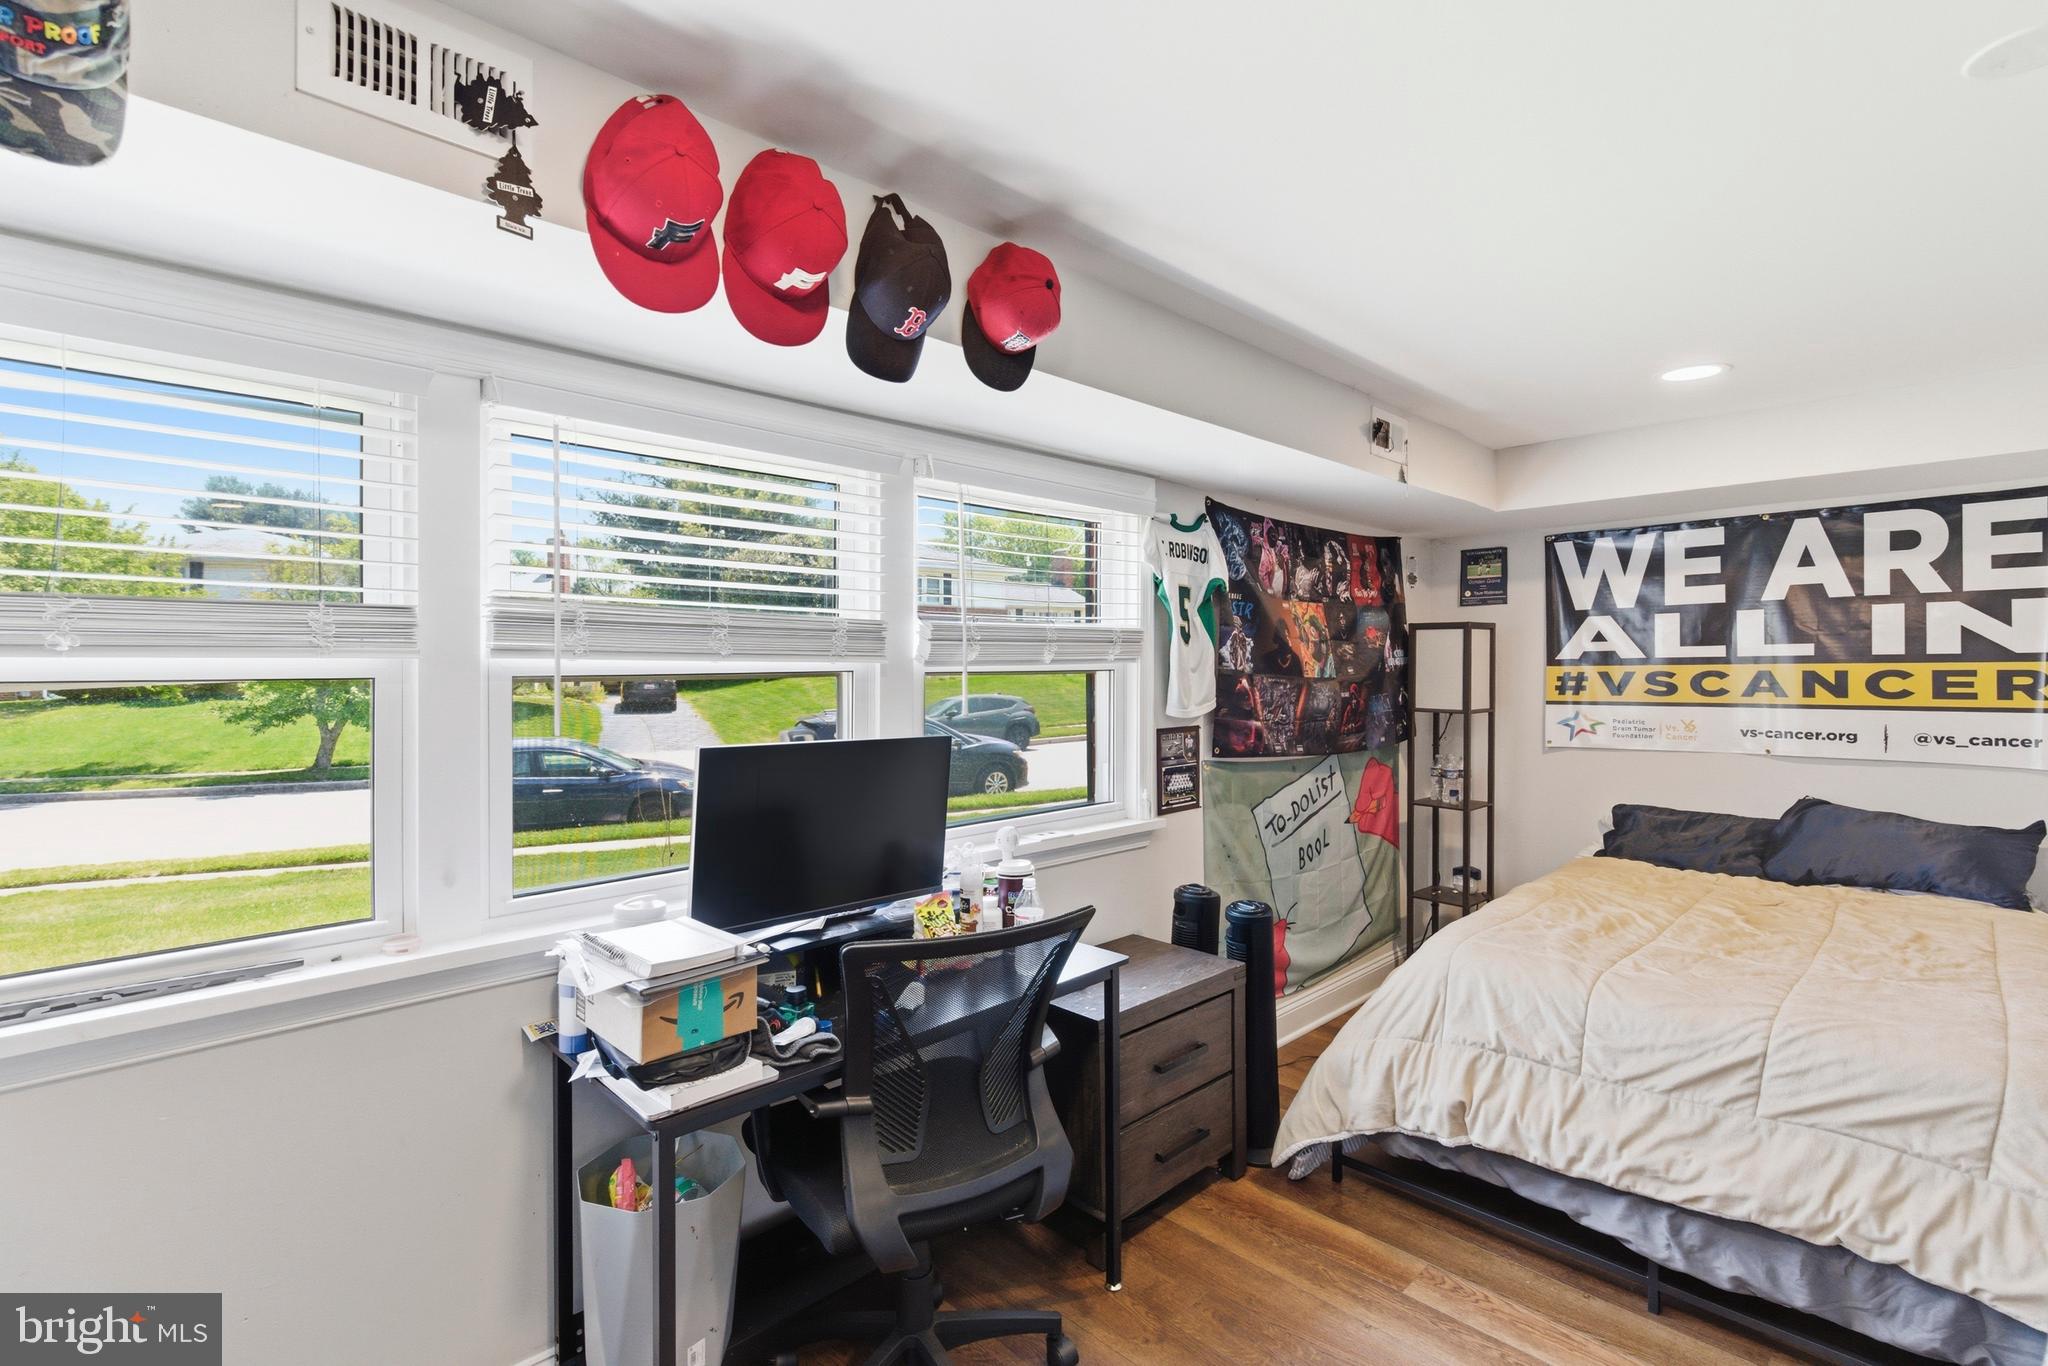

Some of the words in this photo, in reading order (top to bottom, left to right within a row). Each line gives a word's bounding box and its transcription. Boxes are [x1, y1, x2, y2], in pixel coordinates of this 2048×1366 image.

[23, 14, 101, 46] PROOF
[894, 306, 927, 337] B
[1554, 525, 1727, 611] WE
[1760, 495, 2048, 602] ARE
[1178, 585, 1192, 646] 5
[1554, 608, 1815, 660] ALL
[1871, 597, 2048, 656] IN
[1554, 669, 2048, 701] #VSCANCER
[1612, 718, 1646, 726] Pediatric
[1612, 732, 1654, 740] Foundation
[1740, 728, 1858, 744] vs-cancer.org
[1913, 731, 2043, 749] @vs_cancer
[1298, 828, 1330, 870] BOOL
